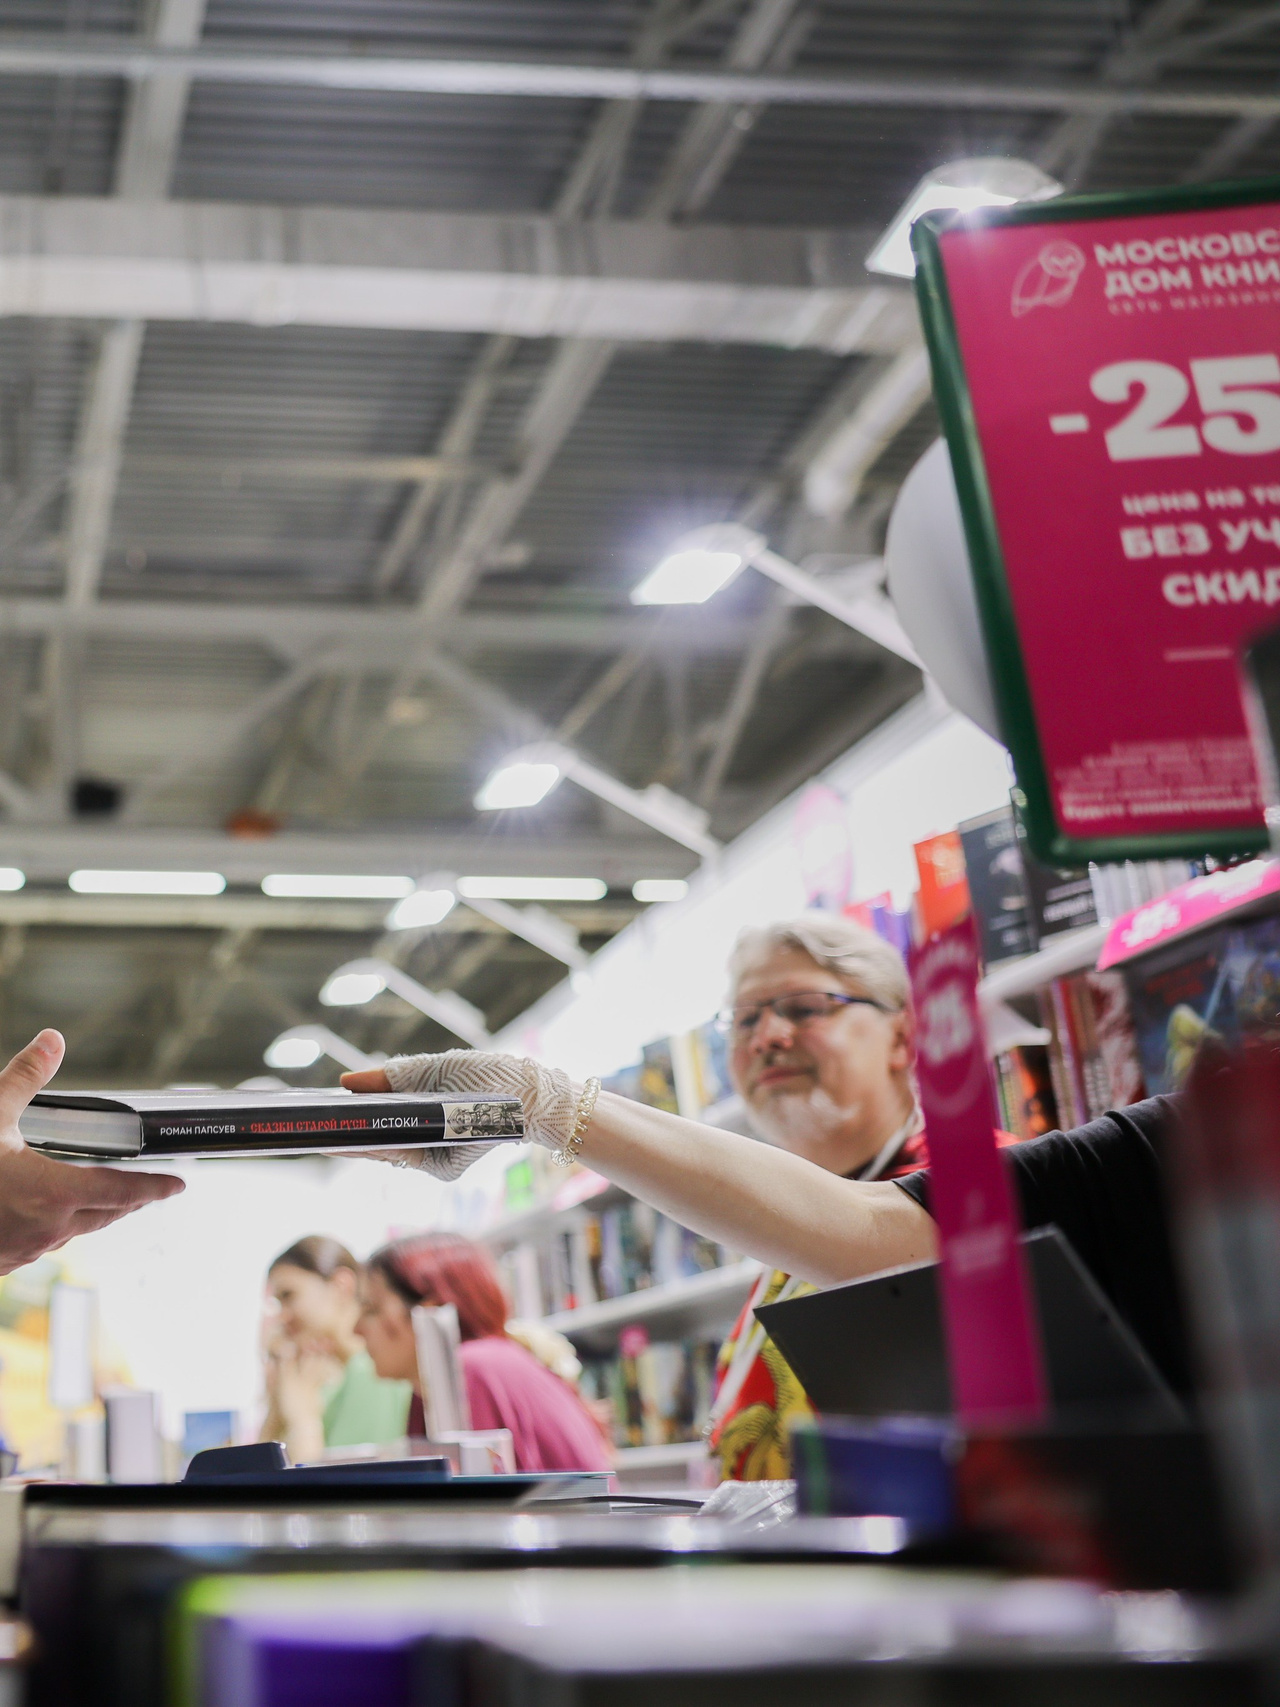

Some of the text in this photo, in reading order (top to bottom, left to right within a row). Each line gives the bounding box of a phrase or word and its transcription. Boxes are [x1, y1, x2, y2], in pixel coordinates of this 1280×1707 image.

[1104, 266, 1193, 299] ДОМ
[1120, 522, 1210, 560] БЕЗ
[160, 1126, 192, 1136] РОМАН
[194, 1124, 236, 1135] ПАПСУЕВ
[250, 1121, 294, 1134] СКАЗКИ
[296, 1118, 337, 1131] СТАРОЙ
[372, 1116, 419, 1129] ИСТОКИ
